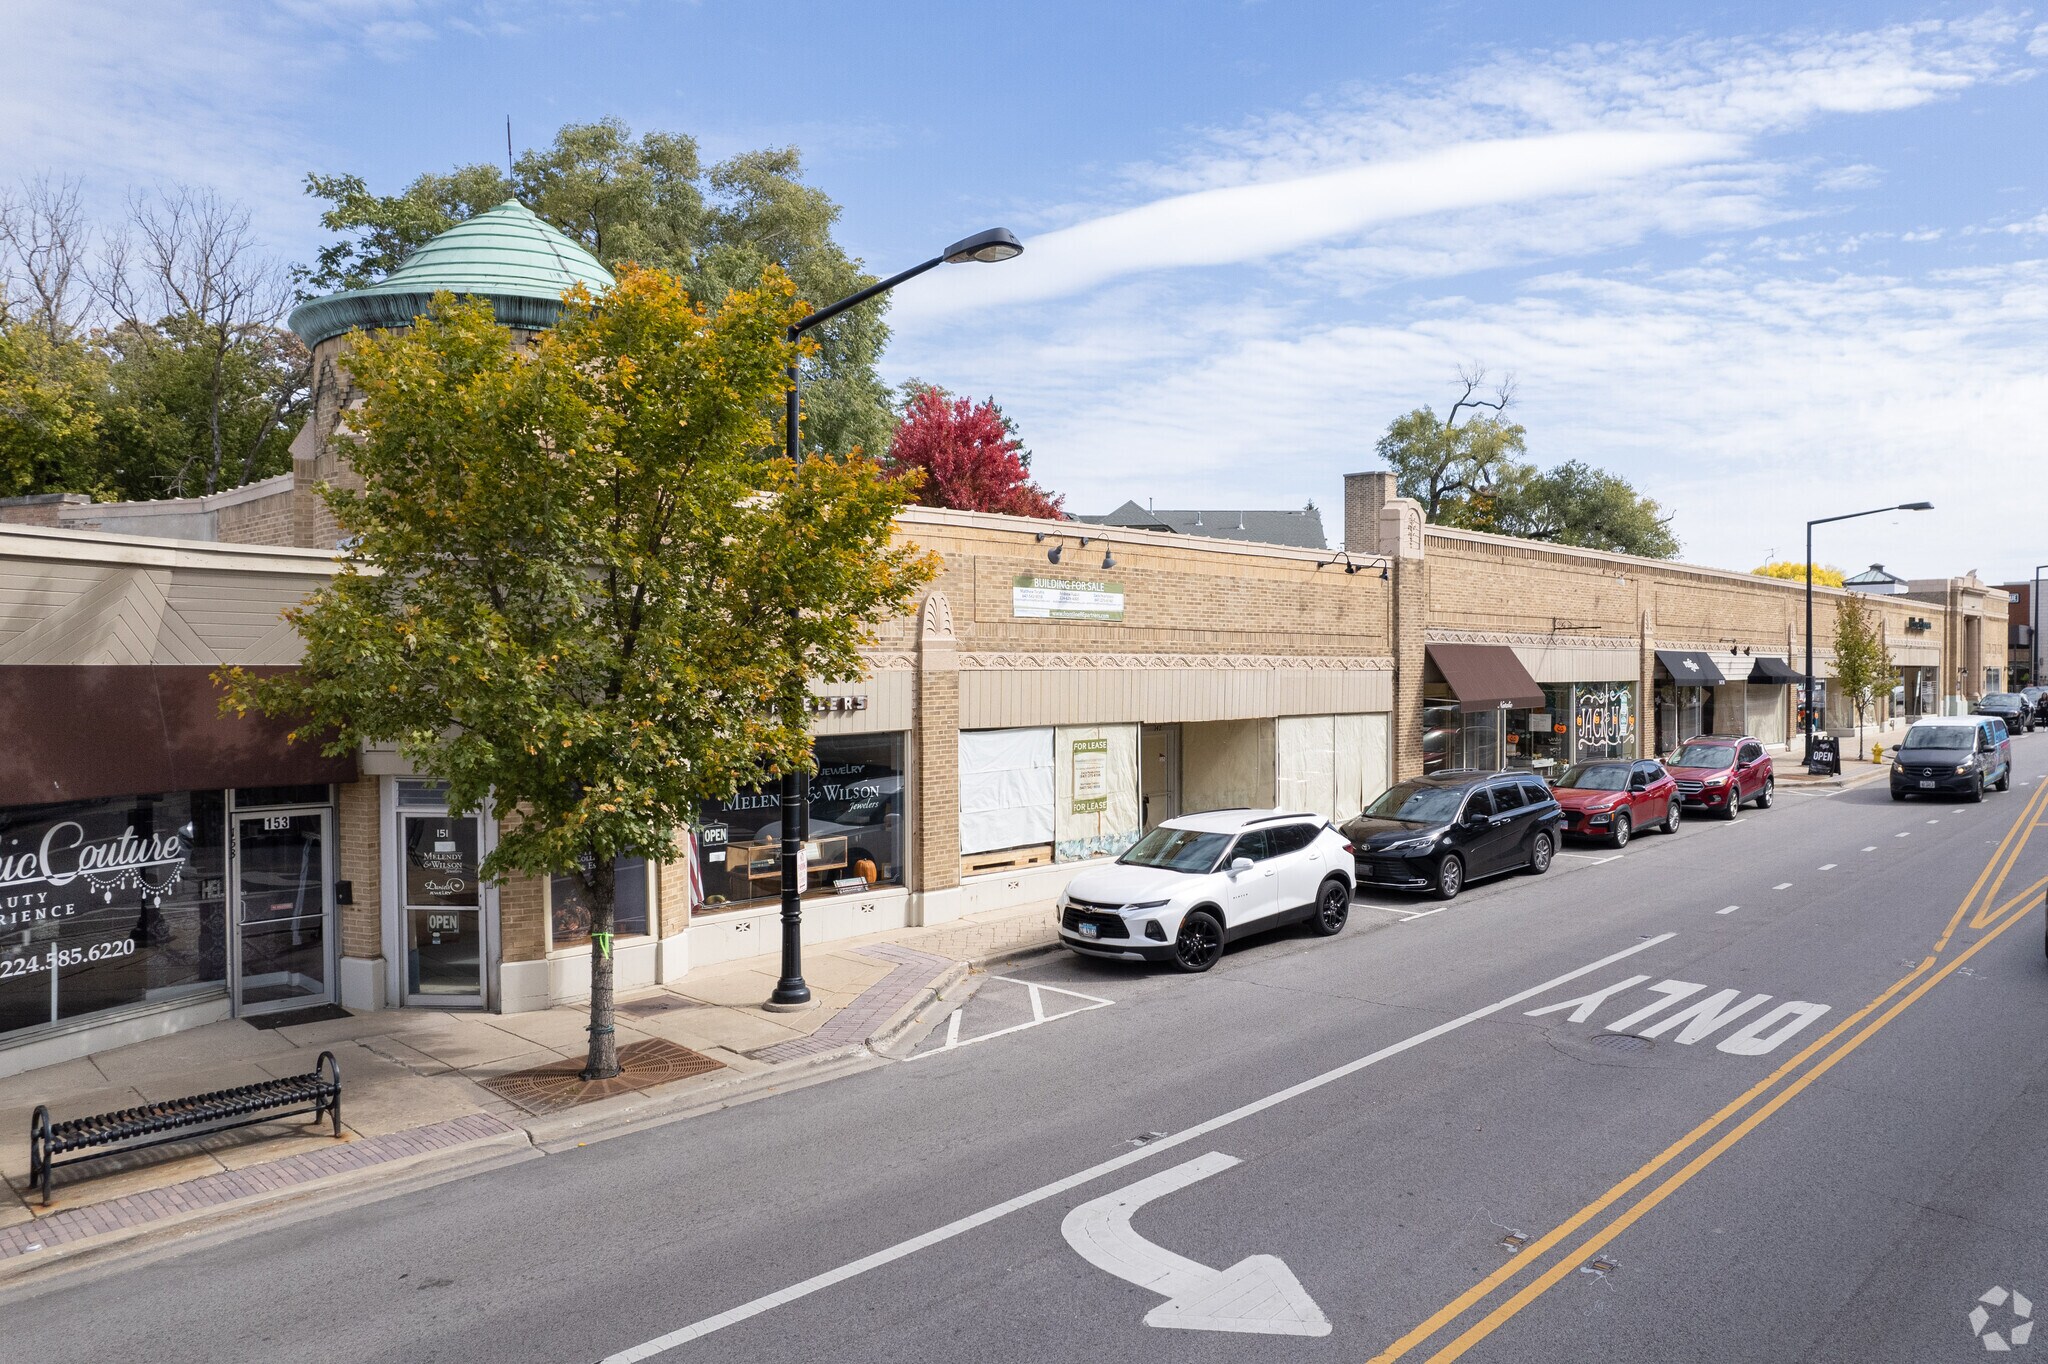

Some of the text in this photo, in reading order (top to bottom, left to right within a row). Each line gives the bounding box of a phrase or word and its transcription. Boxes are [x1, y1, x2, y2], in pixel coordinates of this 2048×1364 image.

[1034, 578, 1105, 592] BUILDING FOR SALE
[1074, 740, 1107, 751] FOR LEASE
[1813, 751, 1834, 762] OPEN
[820, 763, 865, 776] JEWELRY
[721, 792, 781, 812] MELEN
[823, 784, 880, 801] WILSON
[1073, 800, 1107, 812] FOR LEASE
[265, 816, 289, 829] 153
[436, 829, 449, 838] 151
[704, 828, 728, 843] OPEN
[39, 821, 182, 887] Couture
[423, 852, 463, 860] MELENDY
[429, 914, 458, 930] OPEN
[0, 938, 136, 979] 224.585.6220
[1522, 975, 1832, 1056] ONLY
